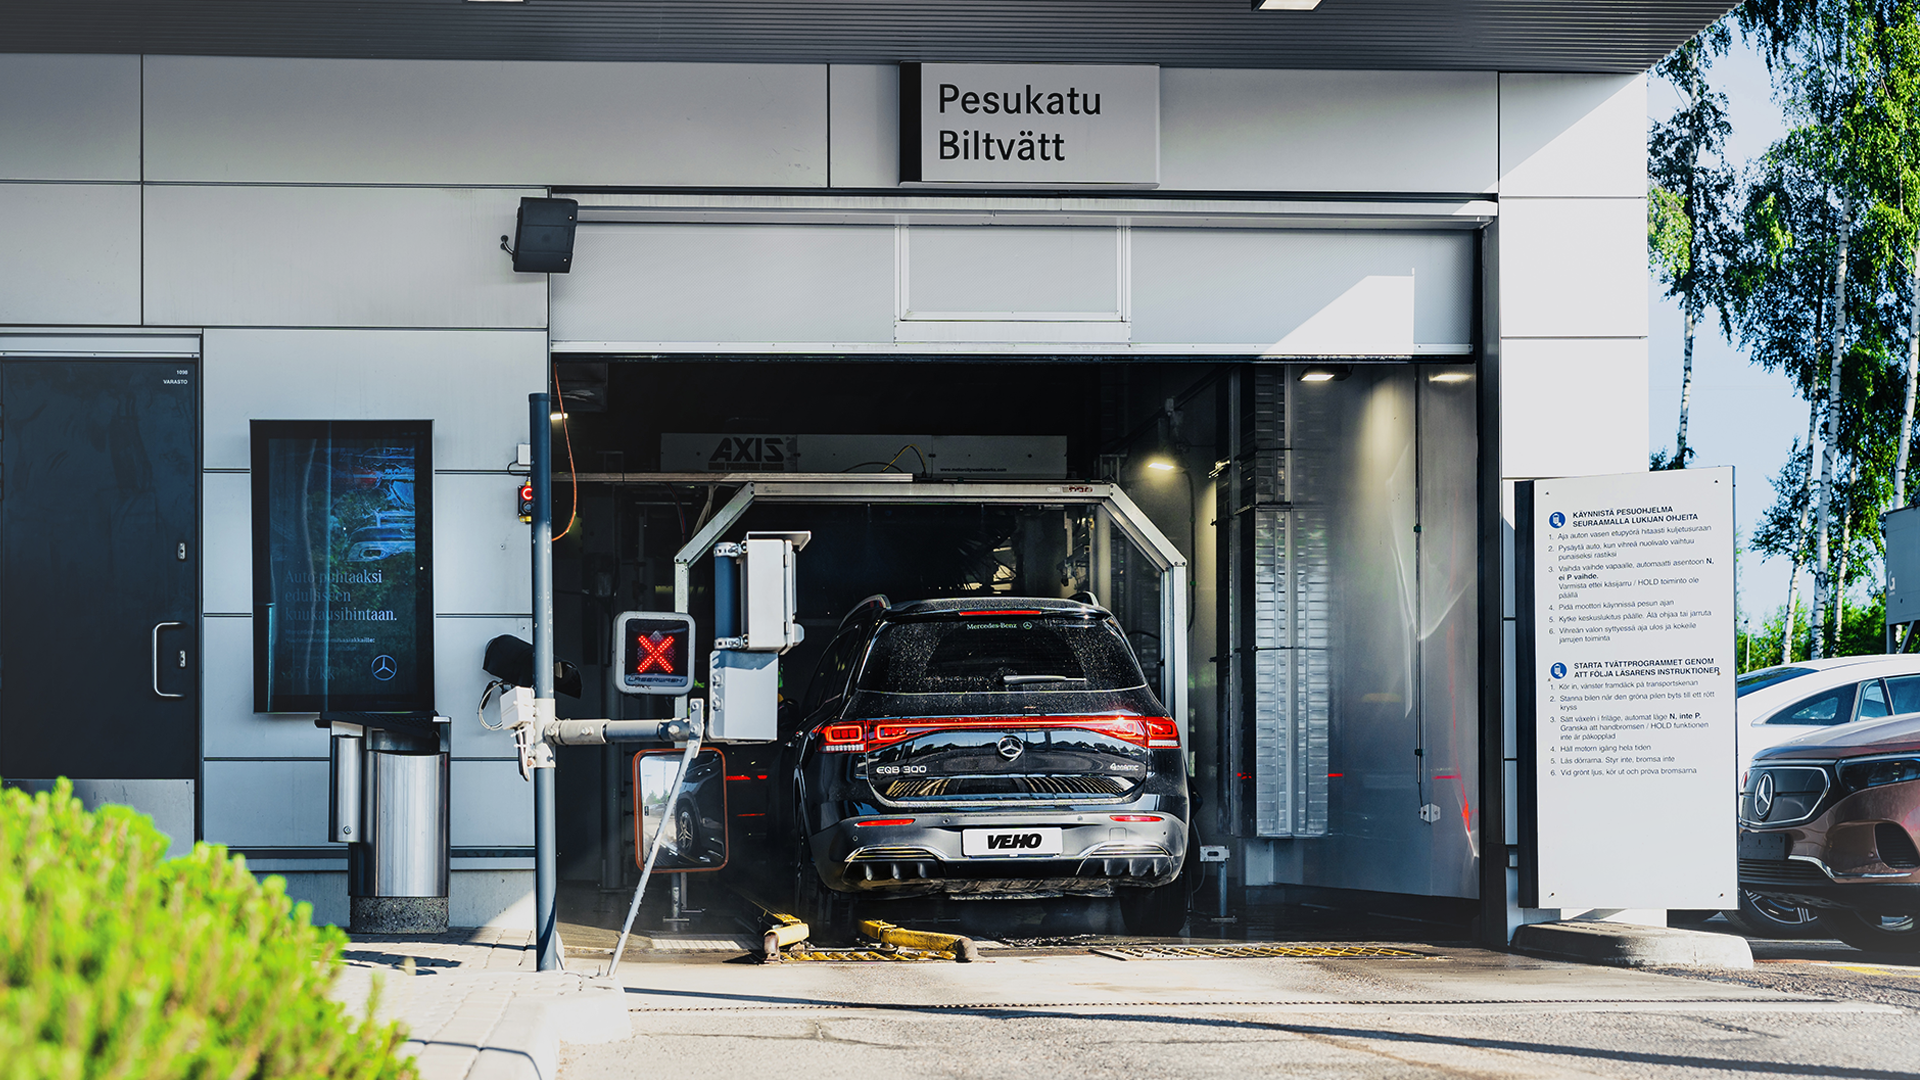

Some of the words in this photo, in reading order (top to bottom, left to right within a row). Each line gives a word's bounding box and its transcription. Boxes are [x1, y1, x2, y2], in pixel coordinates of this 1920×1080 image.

[939, 84, 1101, 115] Pesukatu
[939, 130, 1066, 161] Biltvätt
[709, 437, 784, 462] AXIS
[1573, 510, 1614, 518] KÄYNNISTÄ
[1616, 506, 1673, 516] PESUOHJELMA
[1573, 518, 1629, 527] SEURAAMALLA
[1632, 515, 1664, 524] LUKIJAN
[1666, 513, 1698, 522] OHJEITA
[1667, 525, 1712, 534] kuljetusuraan
[1639, 539, 1668, 547] nuolivalo
[1558, 553, 1592, 561] punaiseksi
[319, 569, 383, 587] puhtaaksi
[1638, 578, 1659, 586] HOLD
[1575, 602, 1601, 610] moottori
[1637, 600, 1658, 608] pesun
[1659, 599, 1674, 607] ajan
[285, 607, 398, 621] kuukausihintaan.
[1659, 610, 1678, 618] ohjaa
[1690, 610, 1712, 618] jarruta
[1637, 624, 1648, 632] aja
[1665, 623, 1672, 631] ja
[1558, 636, 1583, 644] jarrujen
[1605, 658, 1683, 668] TVÄTTPROGRAMMET
[1658, 667, 1719, 675] INSTRUKTIONER
[1636, 679, 1645, 688] på
[1646, 680, 1698, 688] transportskenan
[1649, 692, 1667, 700] pilen
[1668, 691, 1682, 699] byts
[1624, 714, 1651, 722] automat
[1560, 724, 1588, 732] Granska
[1605, 756, 1618, 764] Styr
[876, 767, 900, 775] EQB
[903, 765, 927, 774] 300
[987, 833, 1043, 850] VEHO
